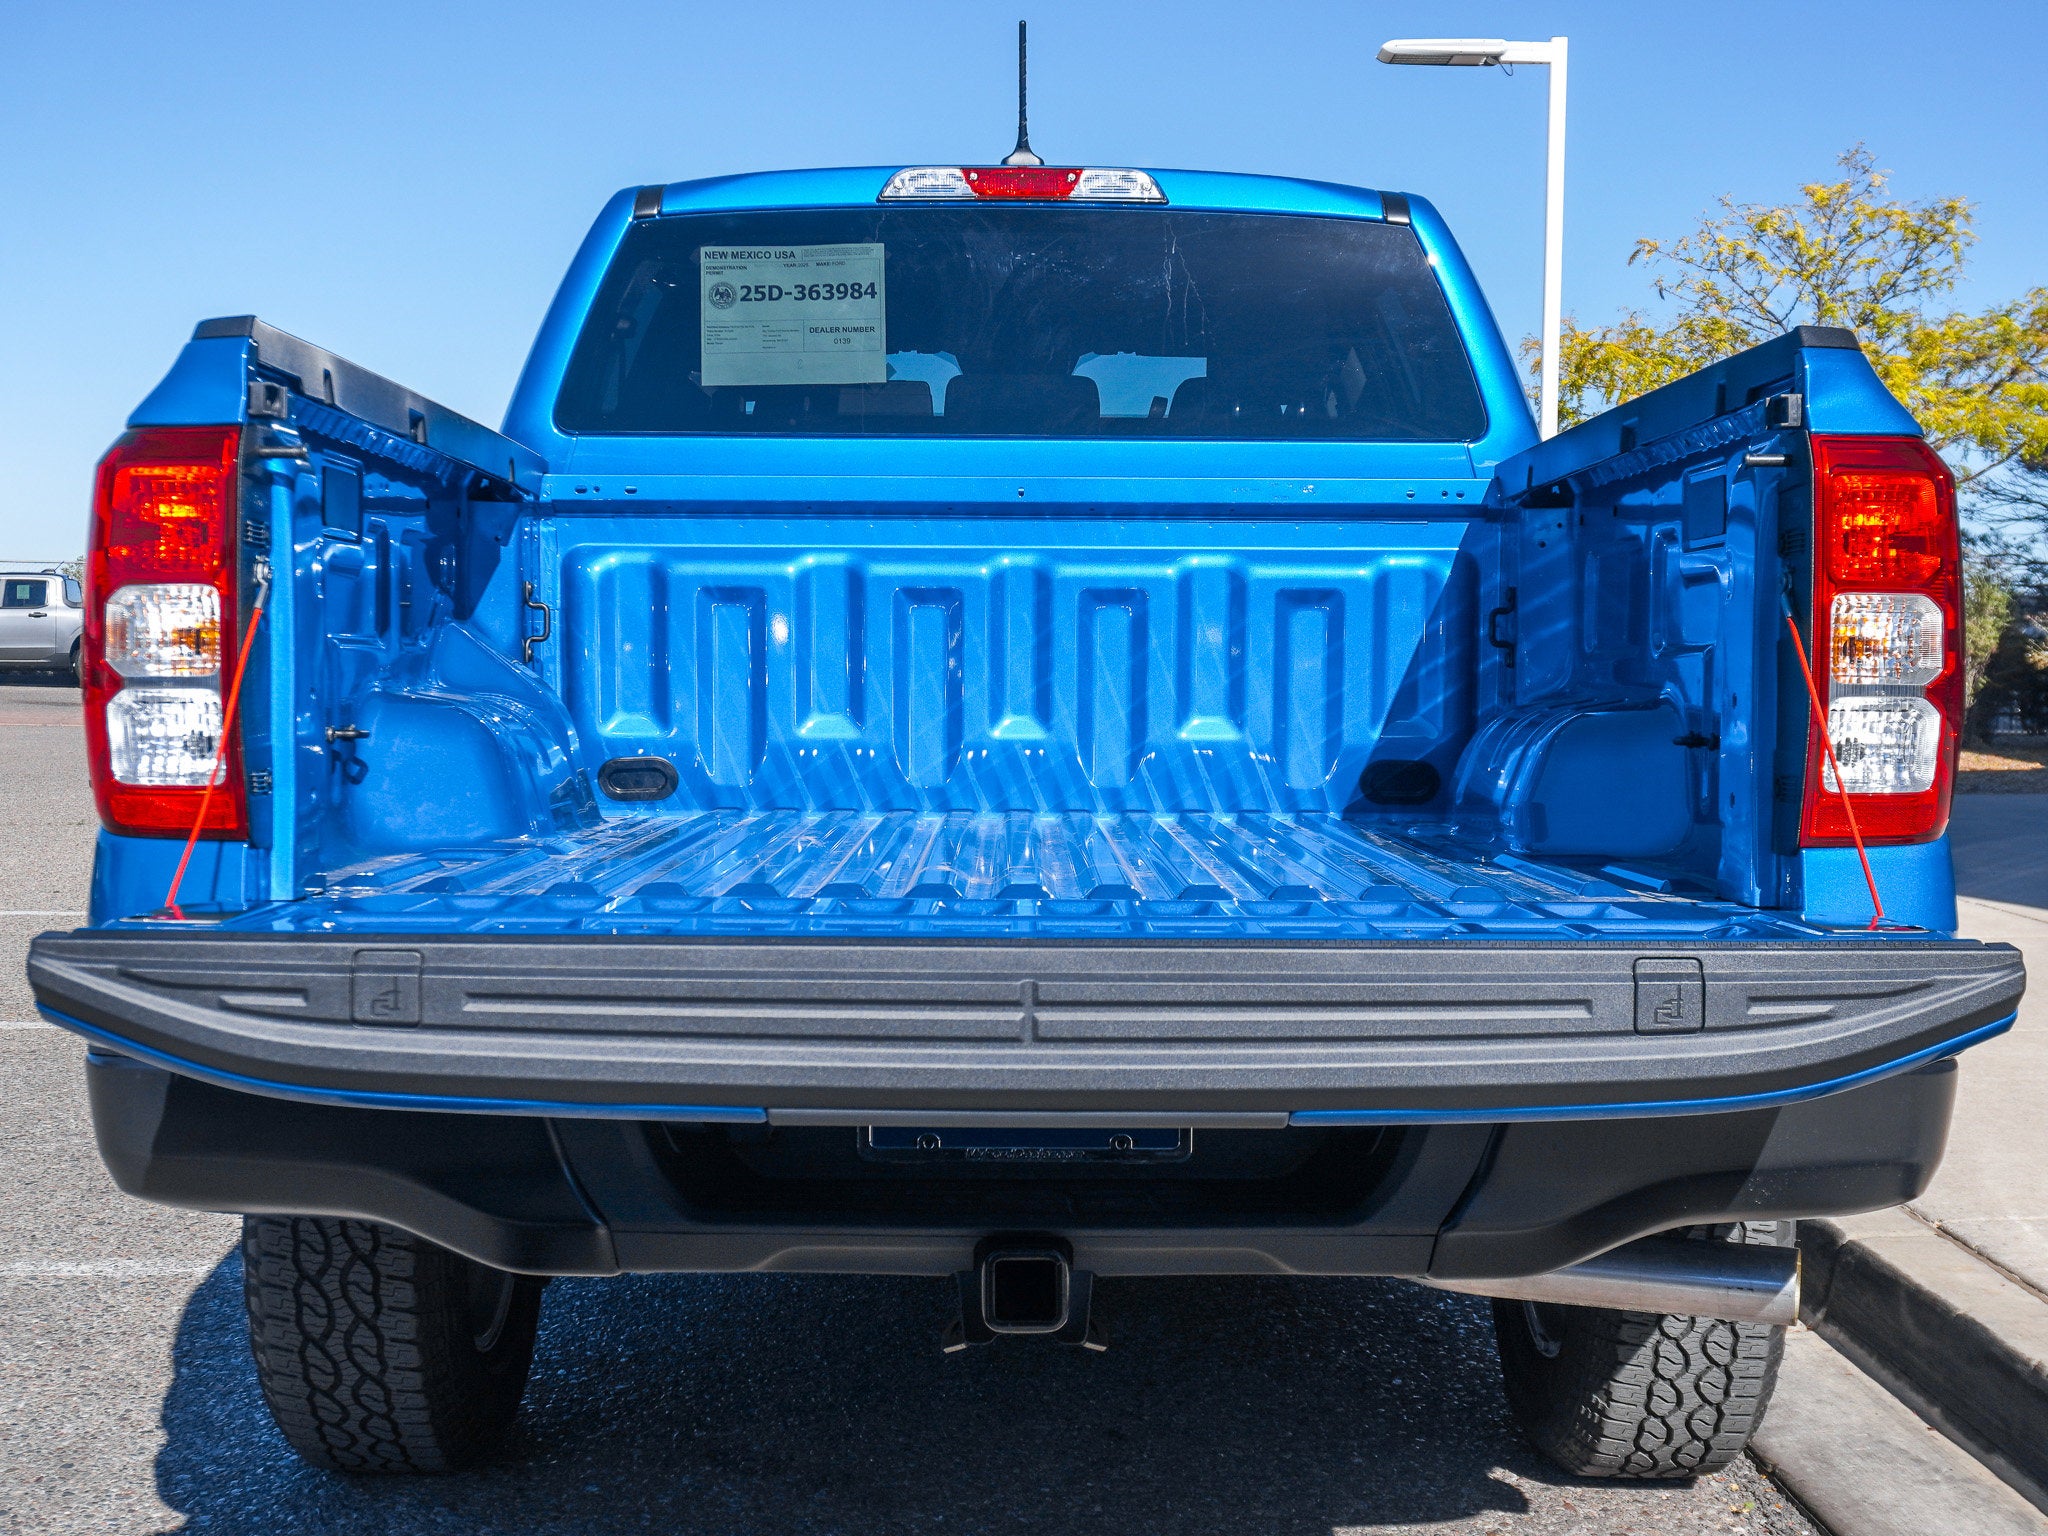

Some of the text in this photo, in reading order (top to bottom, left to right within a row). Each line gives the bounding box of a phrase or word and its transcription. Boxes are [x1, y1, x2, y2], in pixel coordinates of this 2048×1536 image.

[704, 250, 728, 260] NEW
[731, 250, 772, 259] MEXICO
[774, 250, 796, 259] USA
[740, 281, 878, 302] 25D-363984
[809, 325, 876, 334] DEALER NUMBER
[833, 337, 851, 345] 0139
